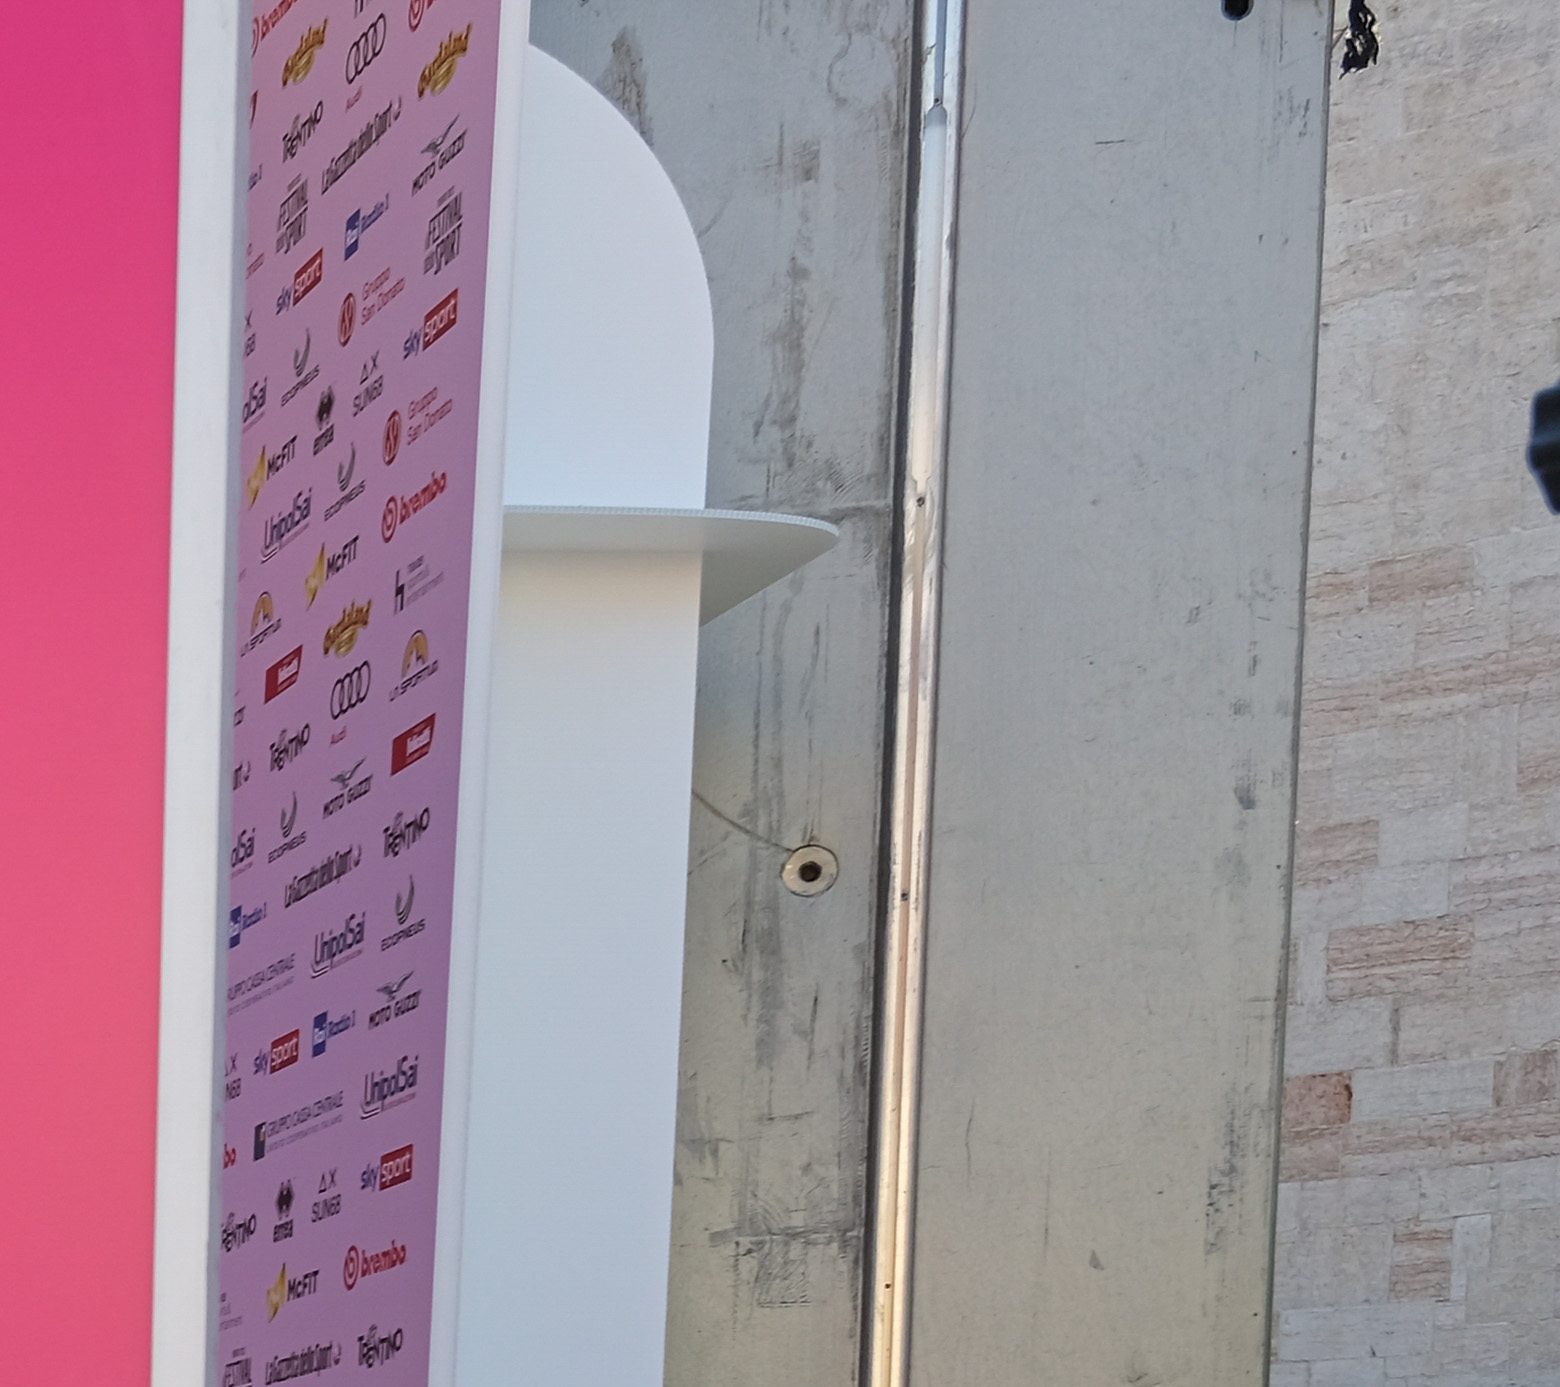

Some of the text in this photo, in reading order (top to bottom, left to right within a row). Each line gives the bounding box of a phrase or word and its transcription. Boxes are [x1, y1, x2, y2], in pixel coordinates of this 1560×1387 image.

[424, 298, 456, 341] sport
[399, 470, 448, 525] brembo
[271, 1035, 298, 1066] sport
[365, 1054, 419, 1108] UnipolSai
[361, 1152, 411, 1192] sky sport
[361, 1240, 407, 1278] brembo
[286, 1269, 319, 1302] McFIT
